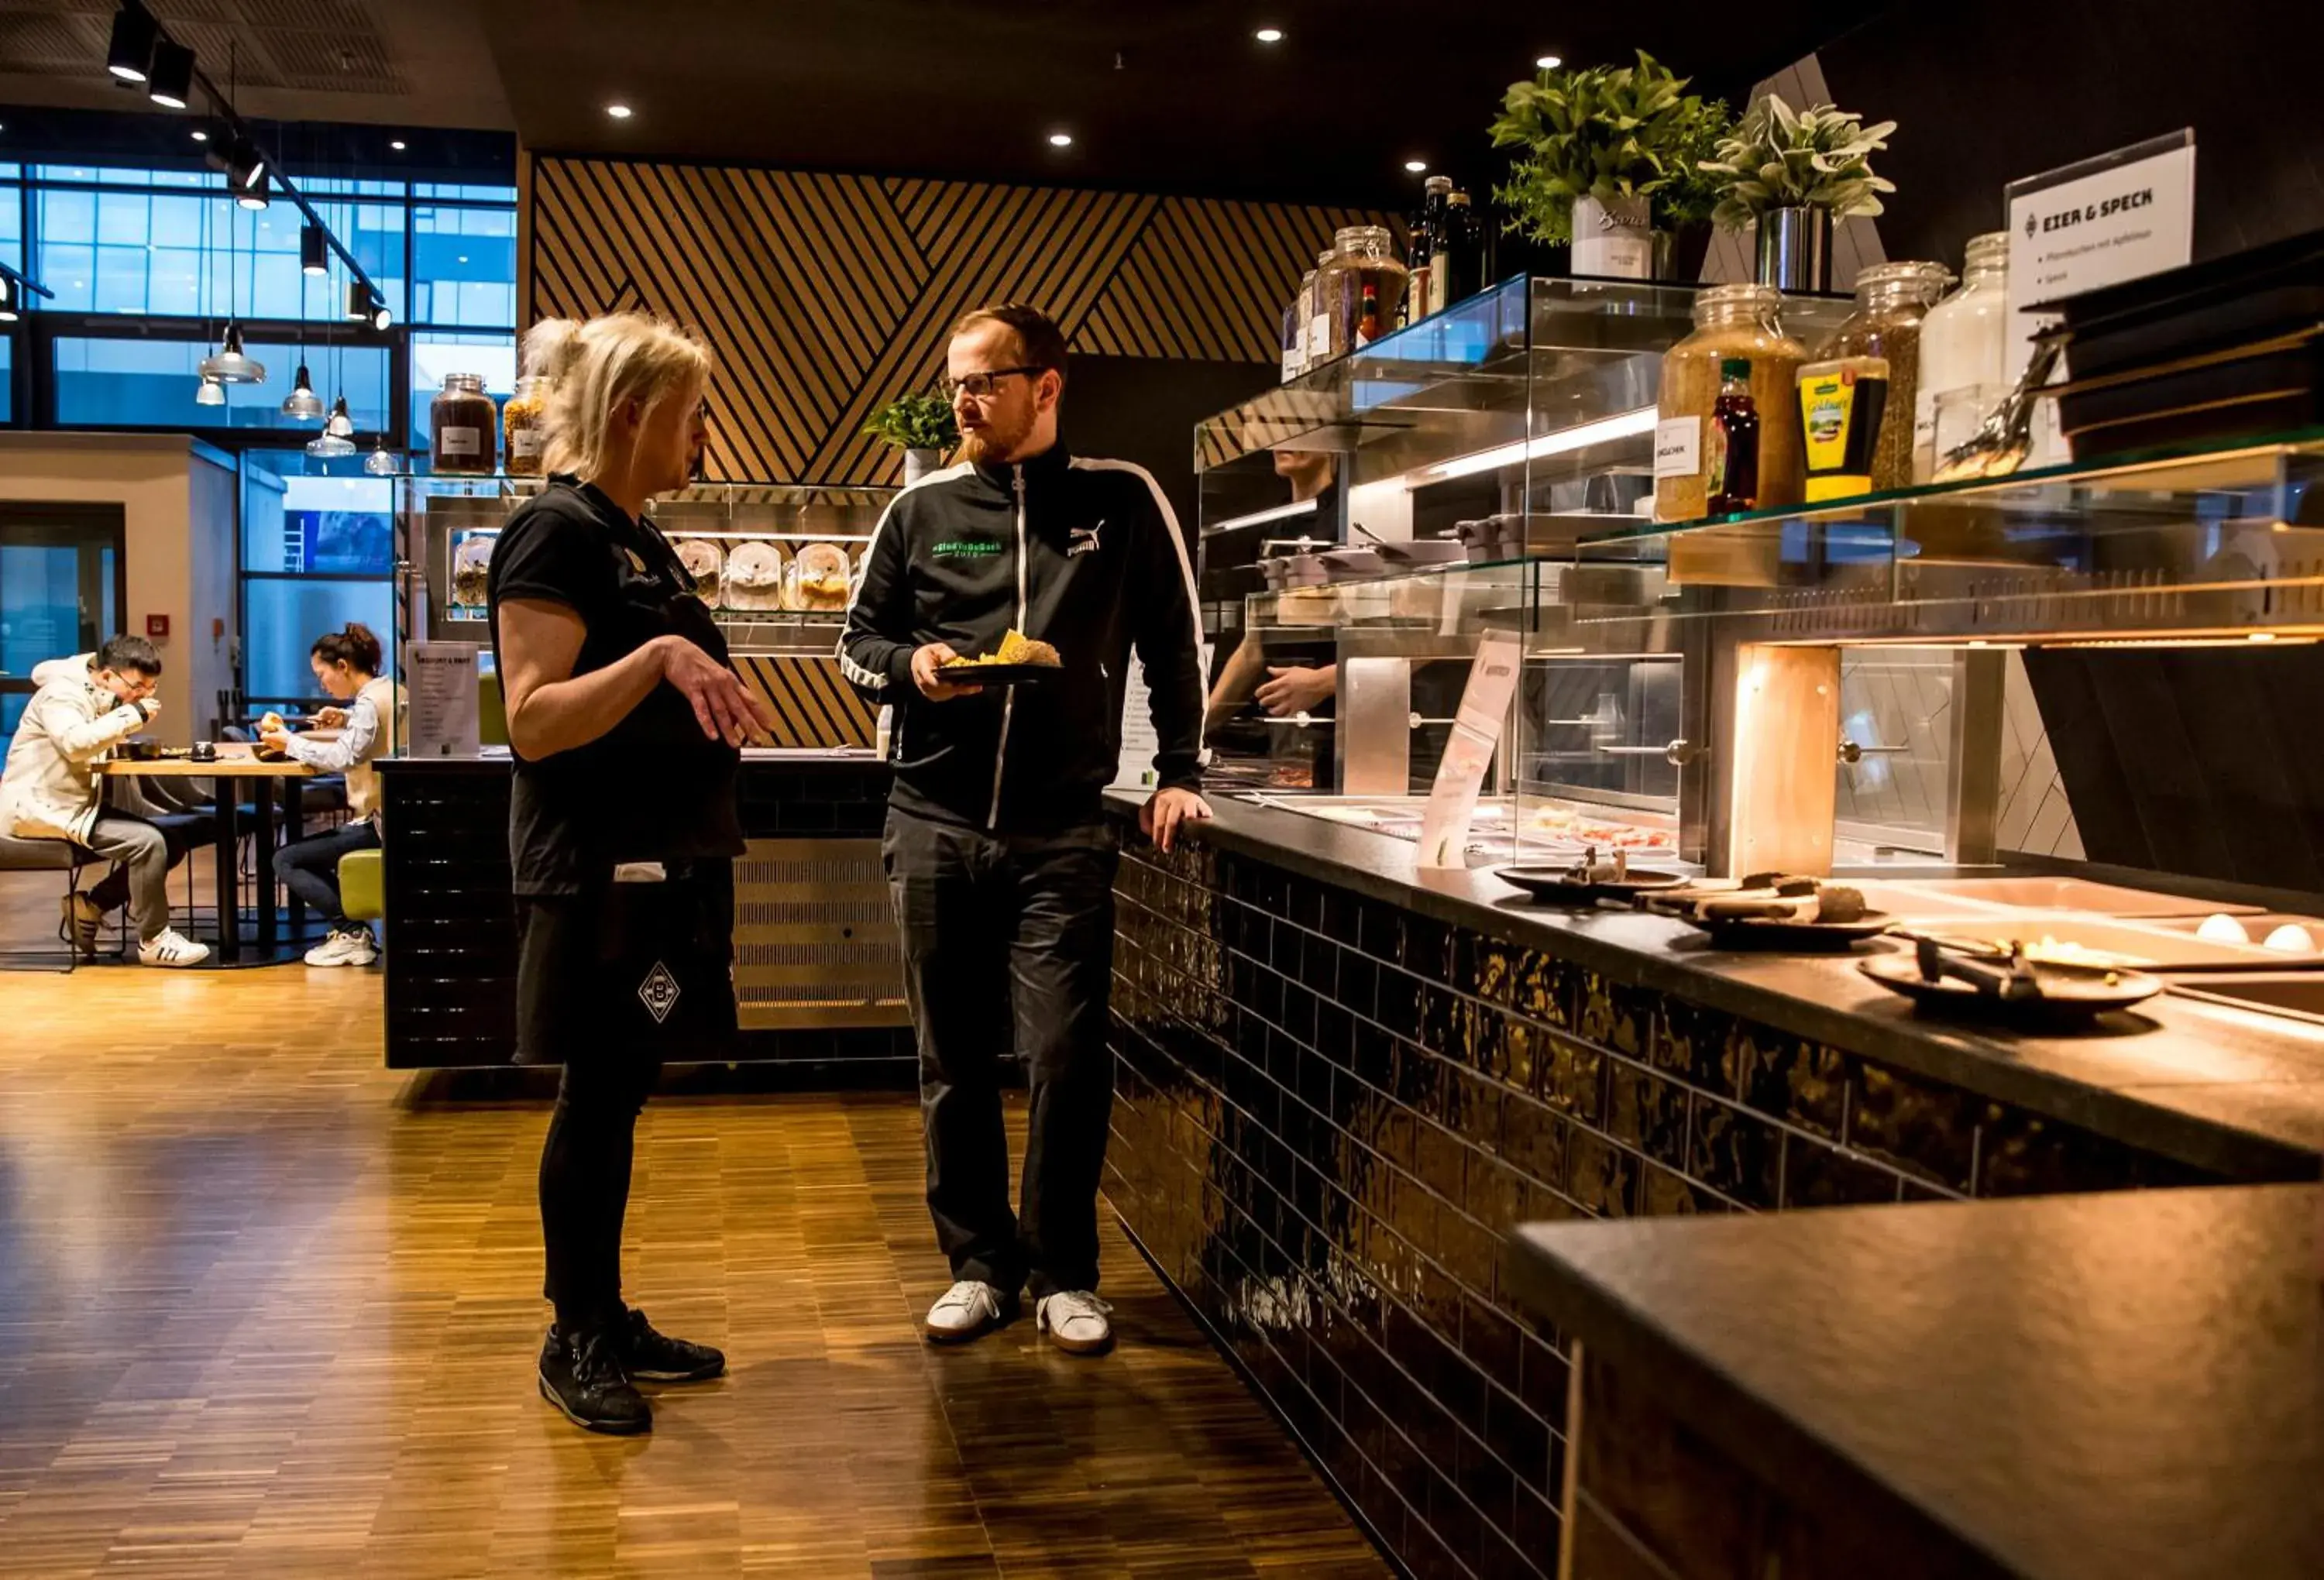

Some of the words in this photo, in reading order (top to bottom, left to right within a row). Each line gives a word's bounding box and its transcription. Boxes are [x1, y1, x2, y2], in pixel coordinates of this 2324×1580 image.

[2043, 208, 2082, 233] EIER
[2085, 204, 2096, 221] &
[2100, 187, 2153, 218] SPECK
